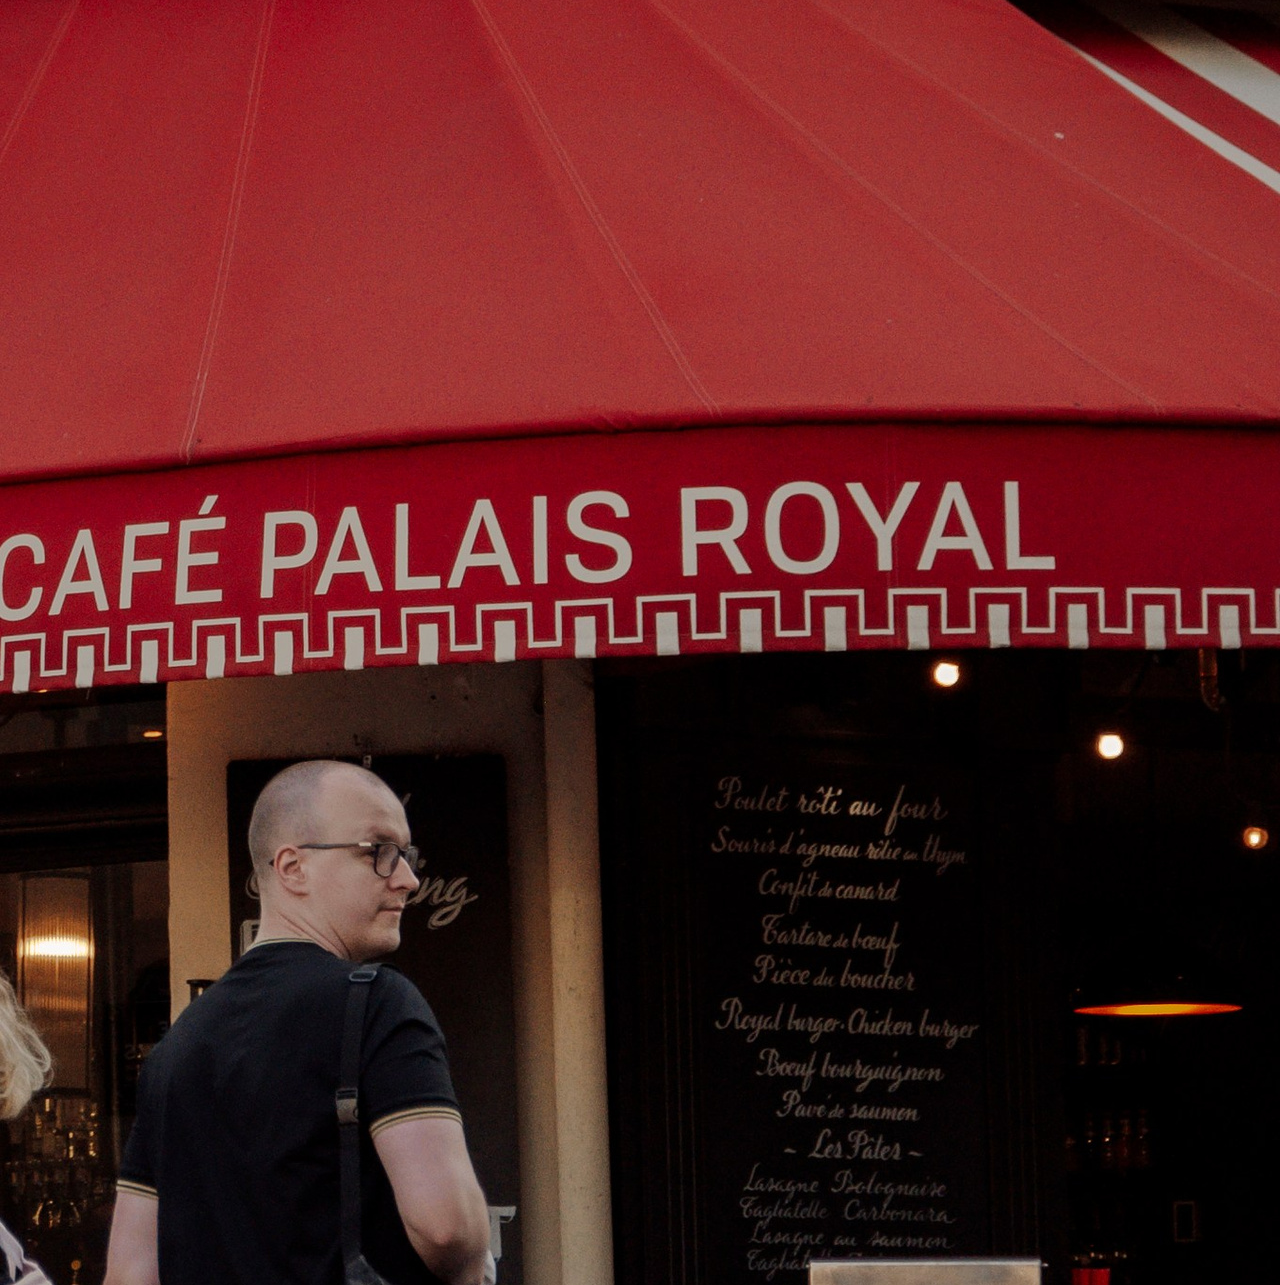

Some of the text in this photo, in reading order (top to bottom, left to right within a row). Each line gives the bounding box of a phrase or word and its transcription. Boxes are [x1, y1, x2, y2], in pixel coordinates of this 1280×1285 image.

[260, 490, 633, 599] PALAIS
[680, 480, 1056, 577] ROYAL
[714, 775, 949, 836] Poulet rôti au four
[711, 825, 776, 853] Souris
[922, 833, 968, 876] thym
[759, 868, 901, 914] Confit de canard
[761, 913, 832, 948] Tartare
[832, 932, 849, 948] de
[753, 954, 917, 991] Pièce du boucher
[715, 996, 783, 1043] Royal
[919, 1009, 980, 1050] burger
[820, 1050, 945, 1092] bourguignon
[848, 1101, 921, 1121] saumon
[808, 1128, 903, 1161] Les Pâtes
[743, 1162, 948, 1210] Lasagne Bolognaise
[843, 1198, 956, 1225] Carbonara
[748, 1222, 956, 1255] Lasagne au saumon
